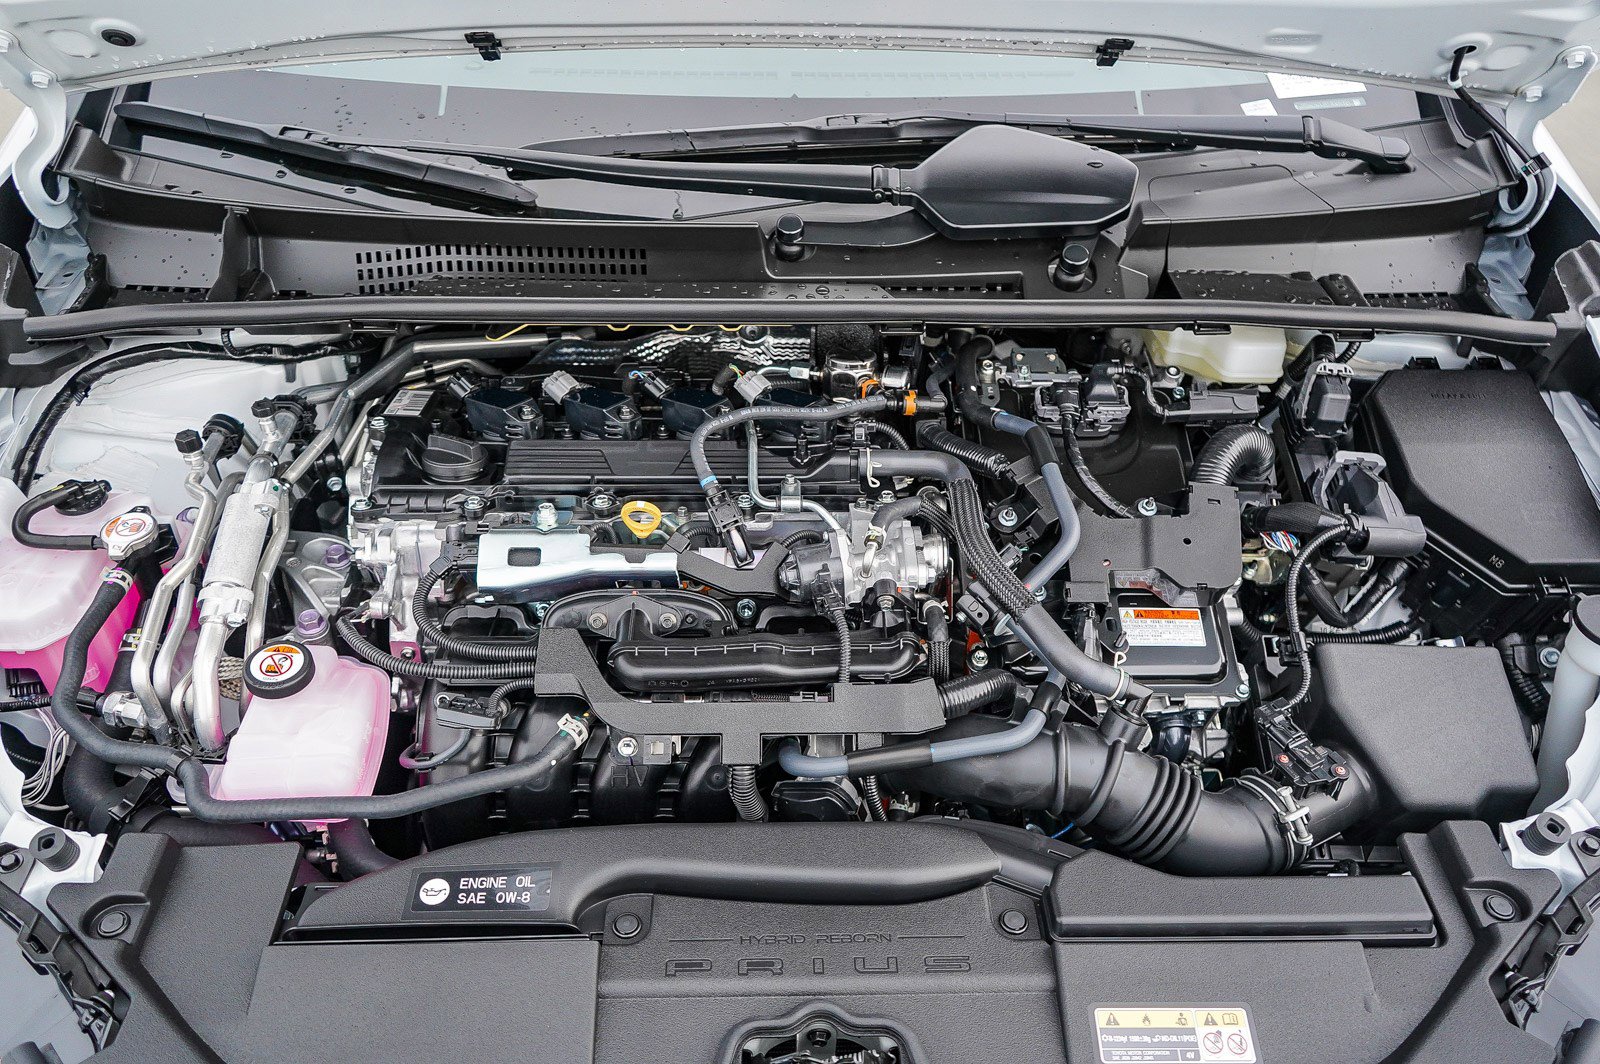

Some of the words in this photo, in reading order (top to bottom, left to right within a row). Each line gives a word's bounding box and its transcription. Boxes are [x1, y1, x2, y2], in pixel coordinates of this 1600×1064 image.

[610, 766, 648, 787] HV
[459, 876, 508, 889] ENGINE
[515, 875, 536, 888] OIL
[457, 892, 487, 904] SAE
[495, 891, 531, 904] 0W-8
[740, 934, 806, 945] HYBRID
[816, 933, 892, 944] REBORN
[665, 955, 971, 976] PRIUS
